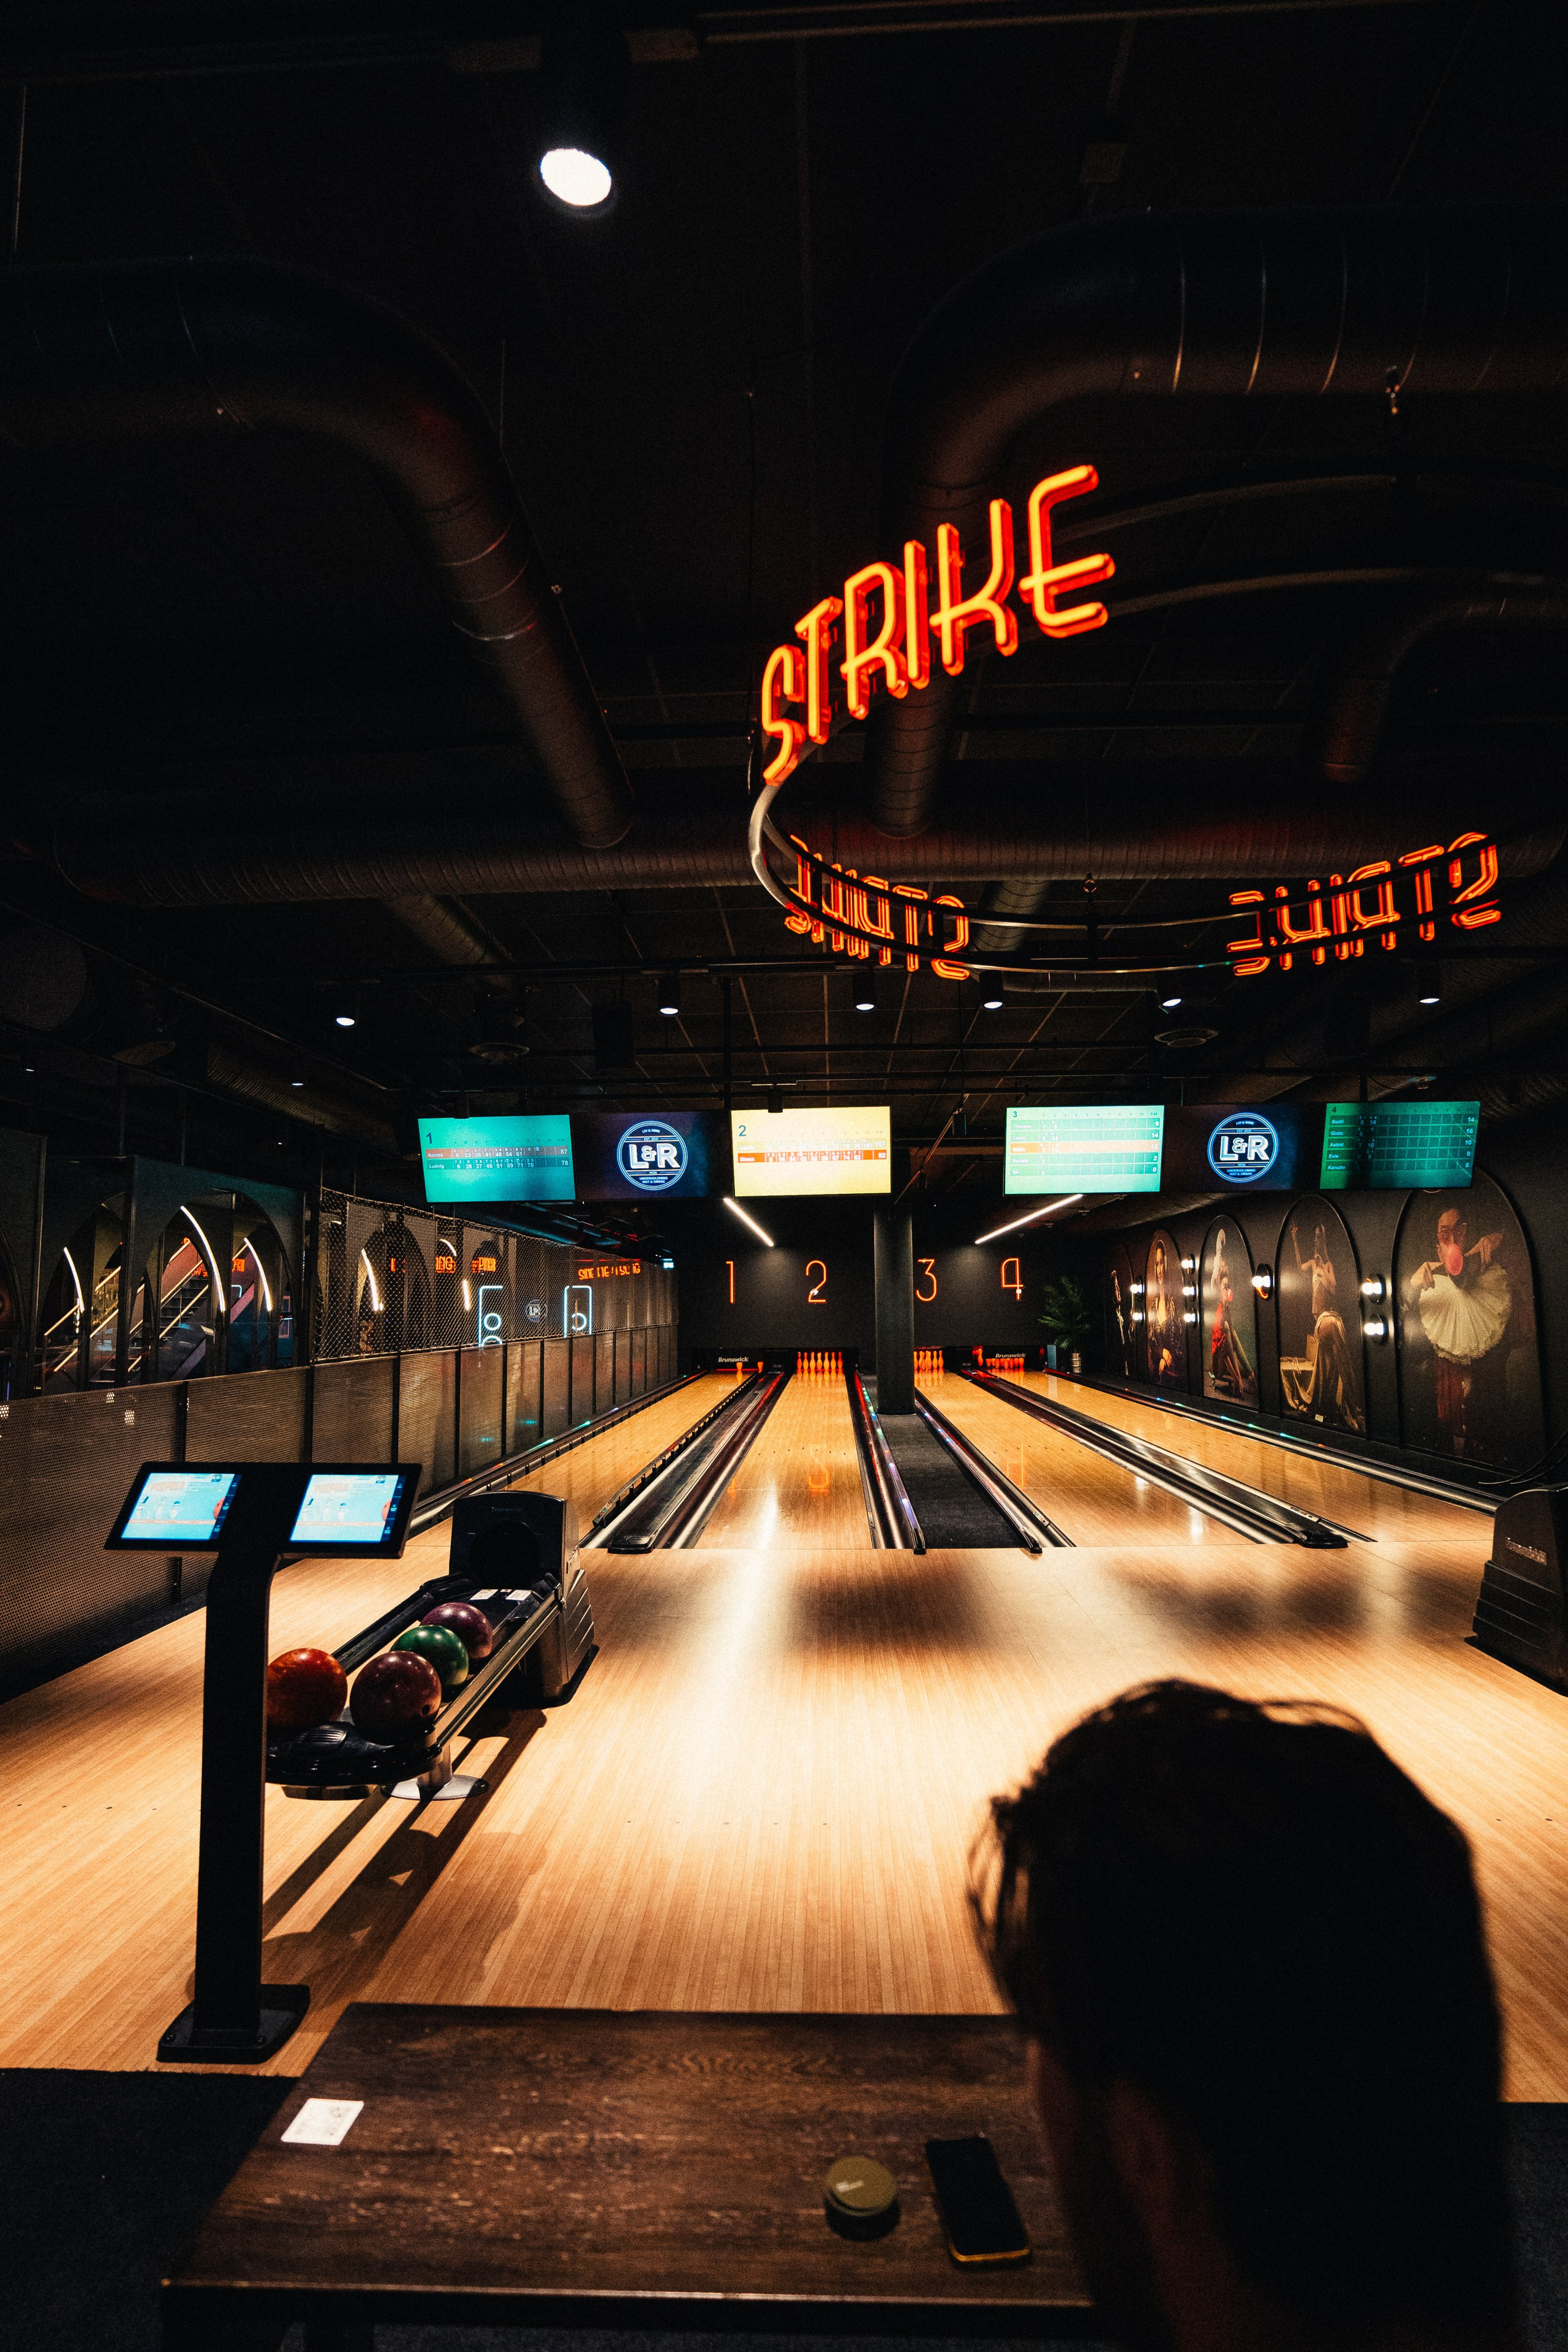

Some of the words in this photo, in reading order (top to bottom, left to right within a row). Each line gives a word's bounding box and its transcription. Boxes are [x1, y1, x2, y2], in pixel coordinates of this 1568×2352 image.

[761, 465, 1115, 786] STRIKE
[426, 1133, 432, 1144] 1
[738, 1125, 747, 1137] 2
[629, 1143, 680, 1169] L&R
[1219, 1135, 1270, 1161] L&R
[725, 1260, 735, 1304] 1
[805, 1259, 827, 1304] 2
[915, 1258, 937, 1302] 3
[1000, 1257, 1025, 1302] 4
